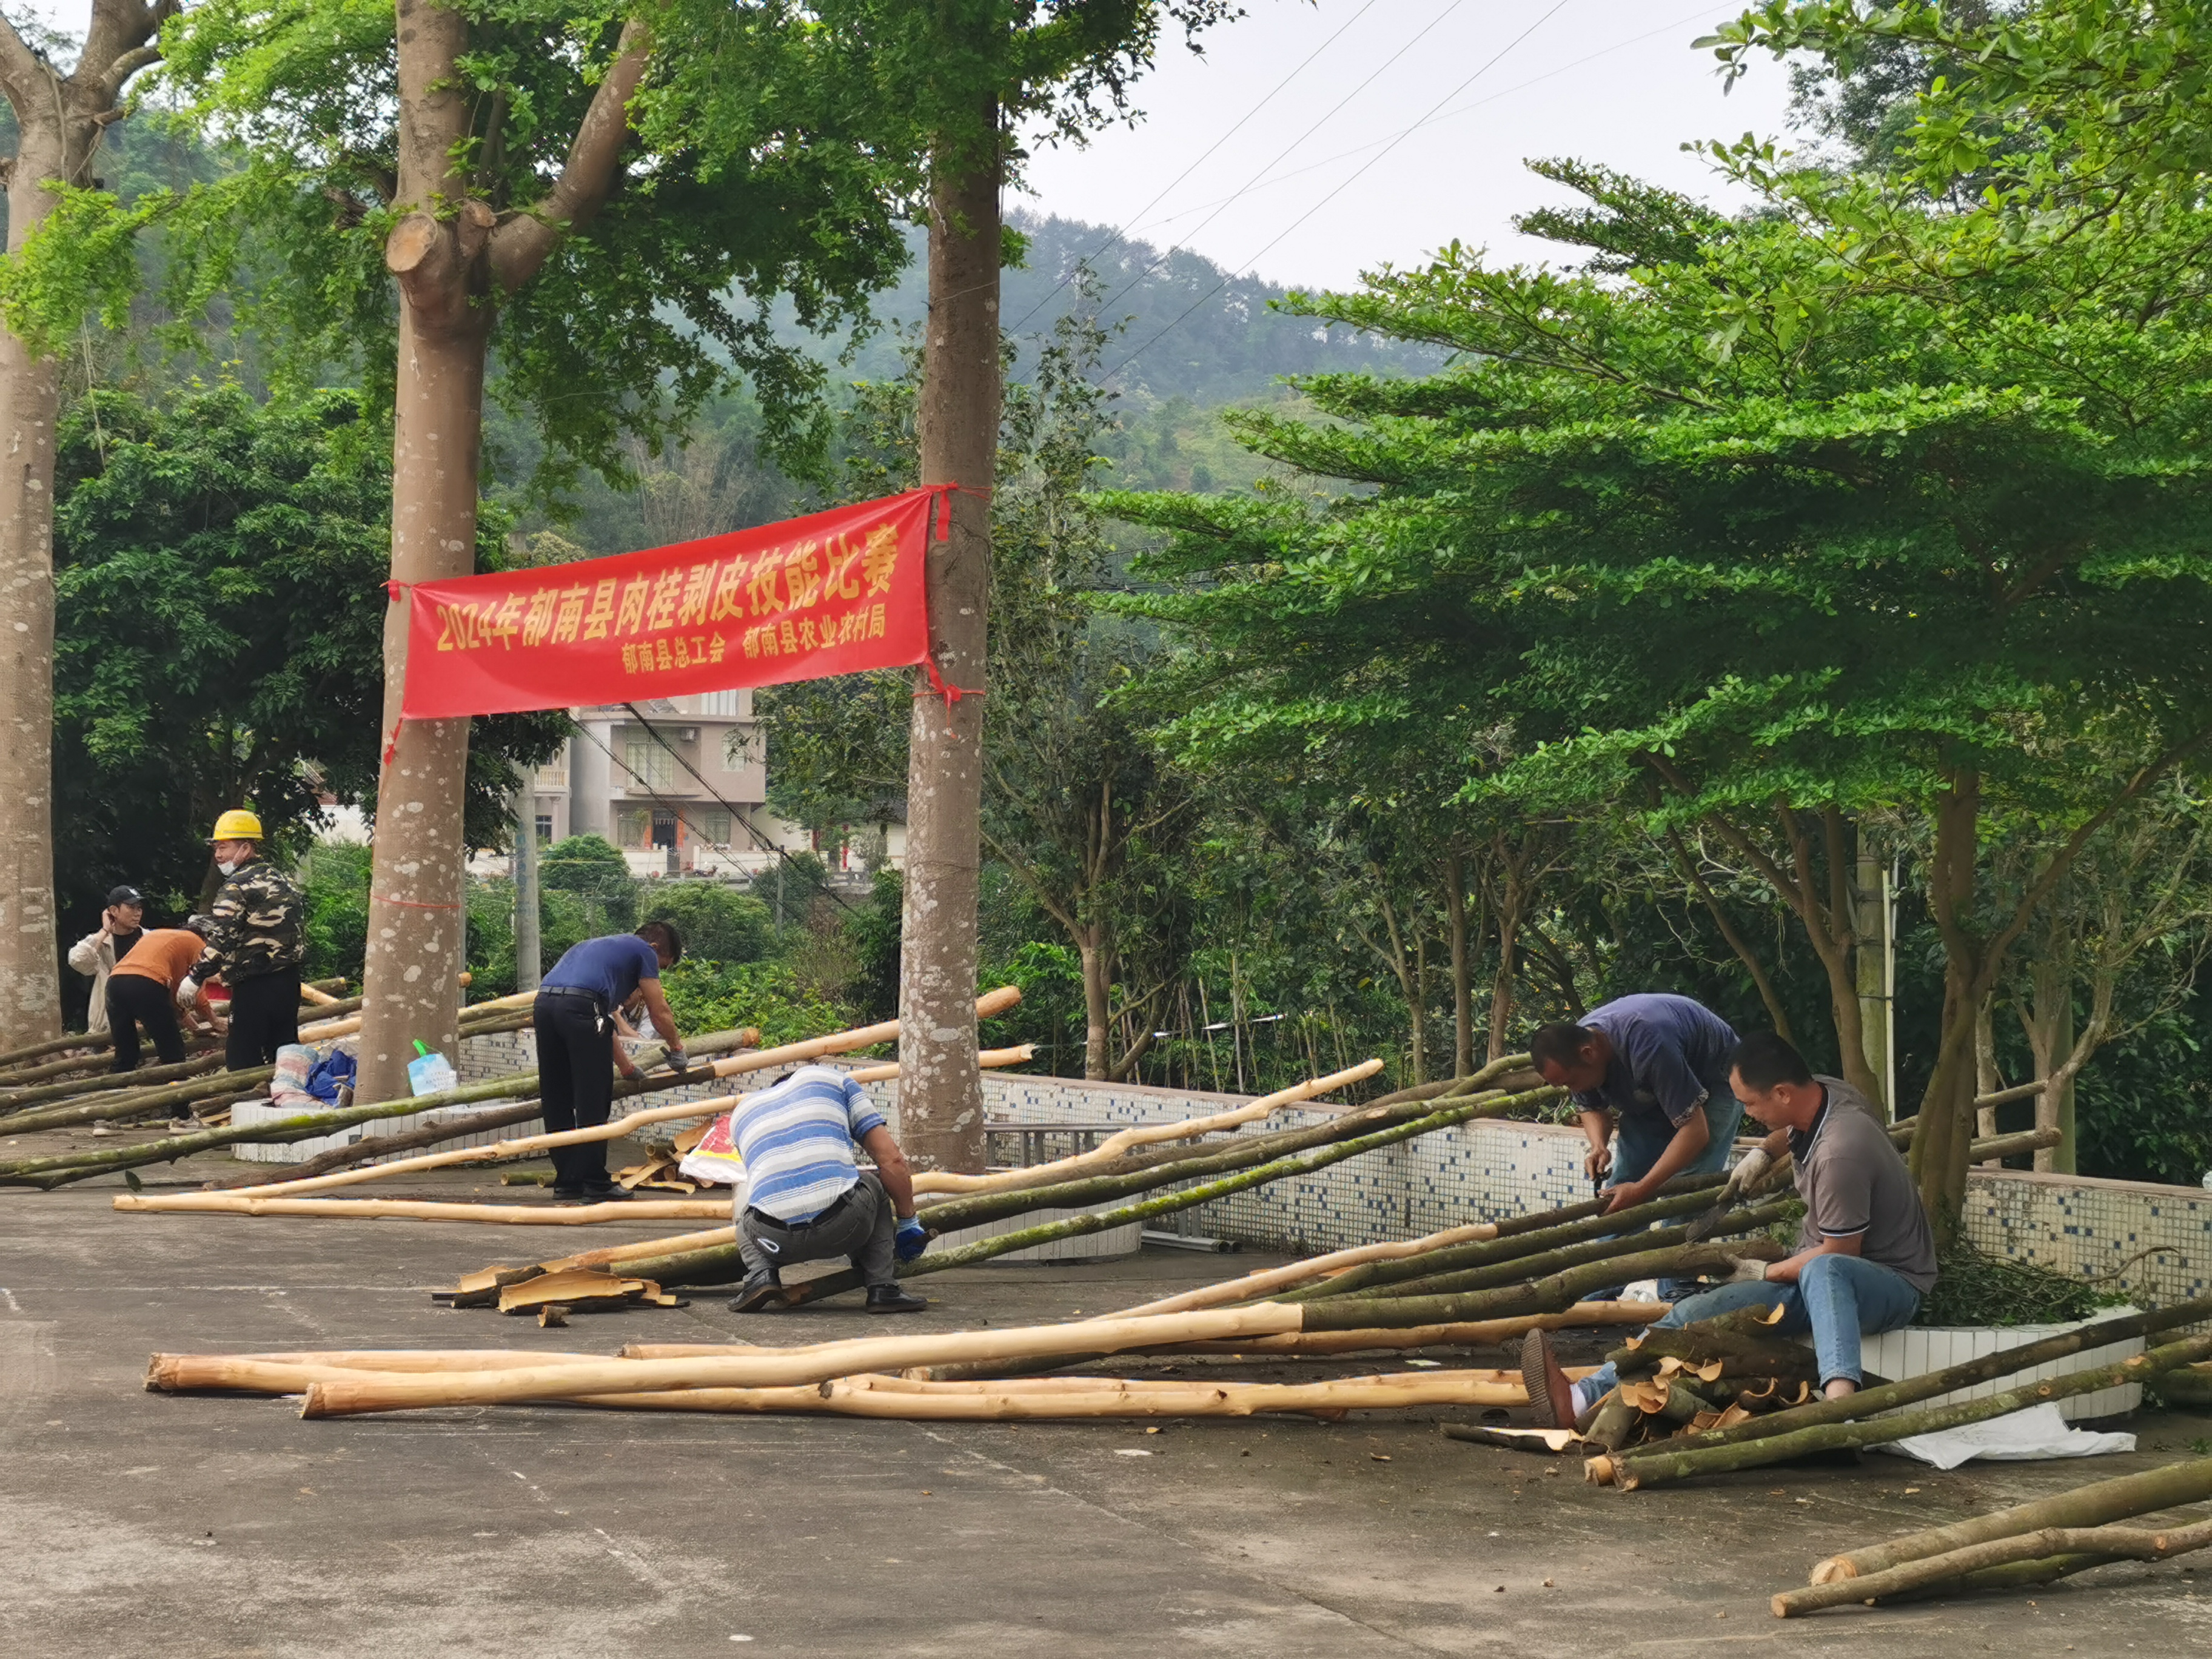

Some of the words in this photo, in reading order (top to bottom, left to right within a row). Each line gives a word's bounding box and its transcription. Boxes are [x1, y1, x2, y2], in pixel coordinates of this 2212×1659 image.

[437, 523, 899, 651] 2024年郁南县肉桂剥皮技能比赛
[622, 632, 725, 674] 郁南县总工会
[743, 603, 886, 659] 郁南县农业农村局
